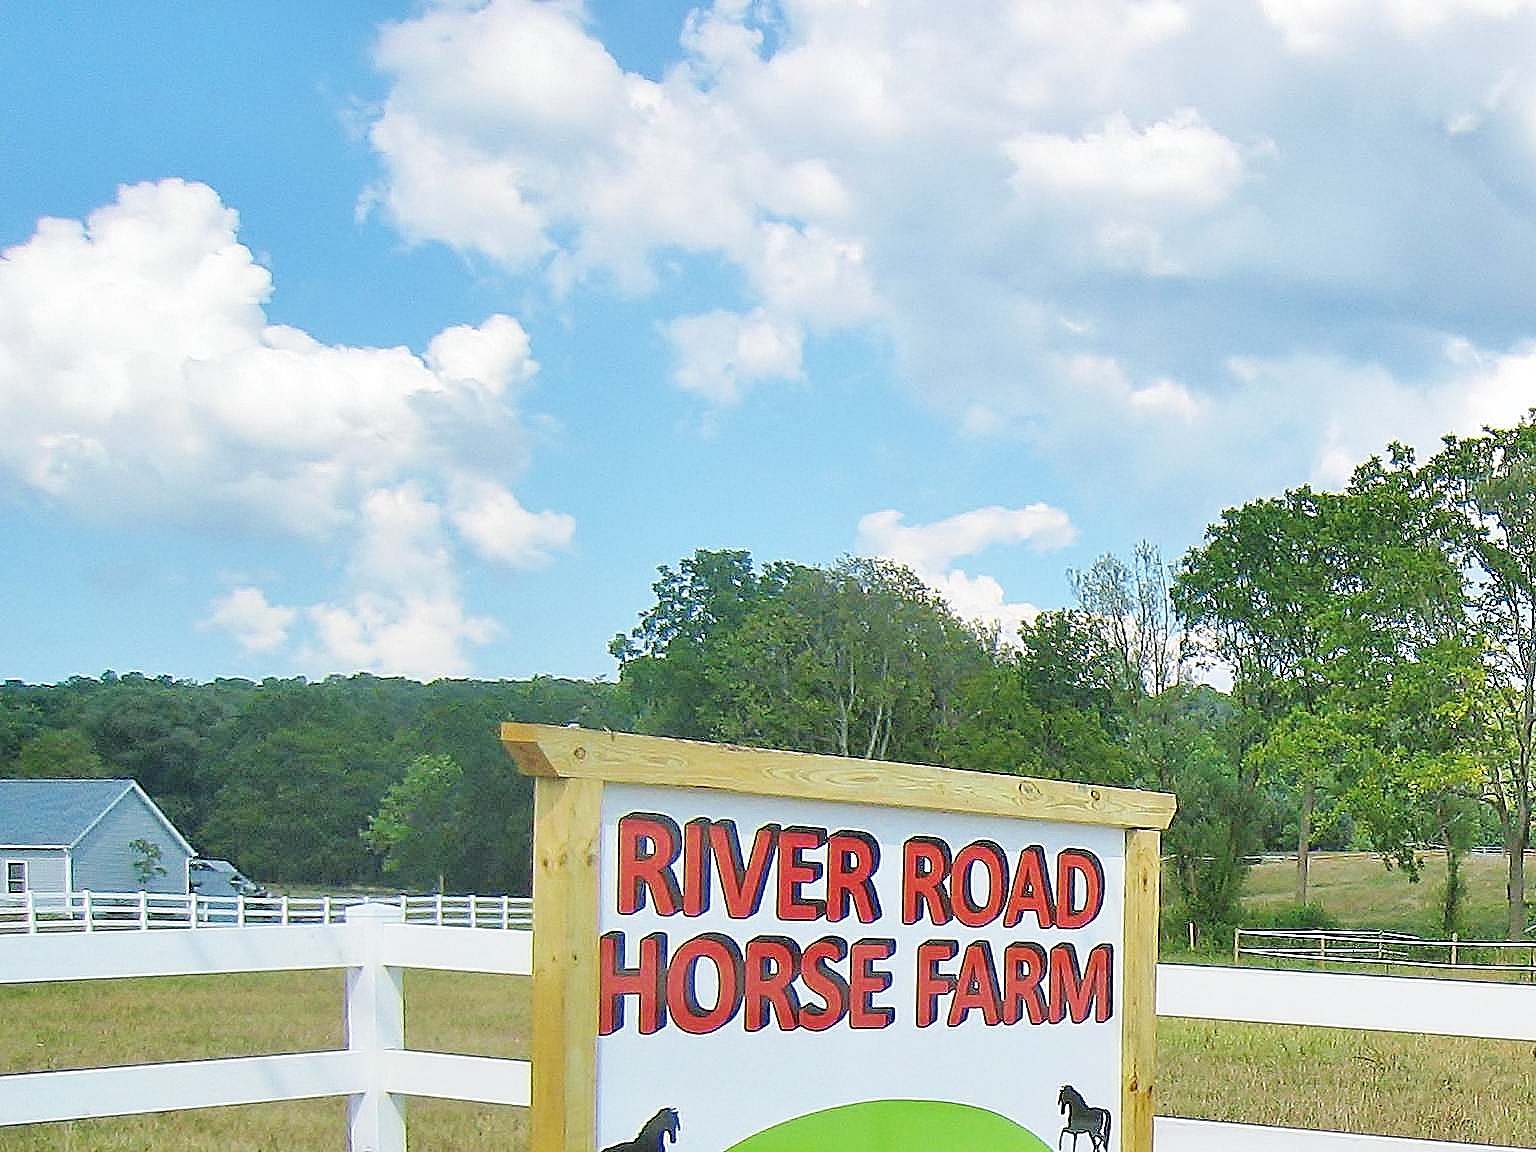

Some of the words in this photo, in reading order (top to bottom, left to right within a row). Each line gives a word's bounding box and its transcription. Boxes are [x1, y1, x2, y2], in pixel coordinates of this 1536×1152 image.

[617, 811, 882, 923] RIVER
[901, 835, 1105, 930] ROAD
[599, 931, 896, 1036] HORSE
[916, 938, 1113, 1028] FARM
